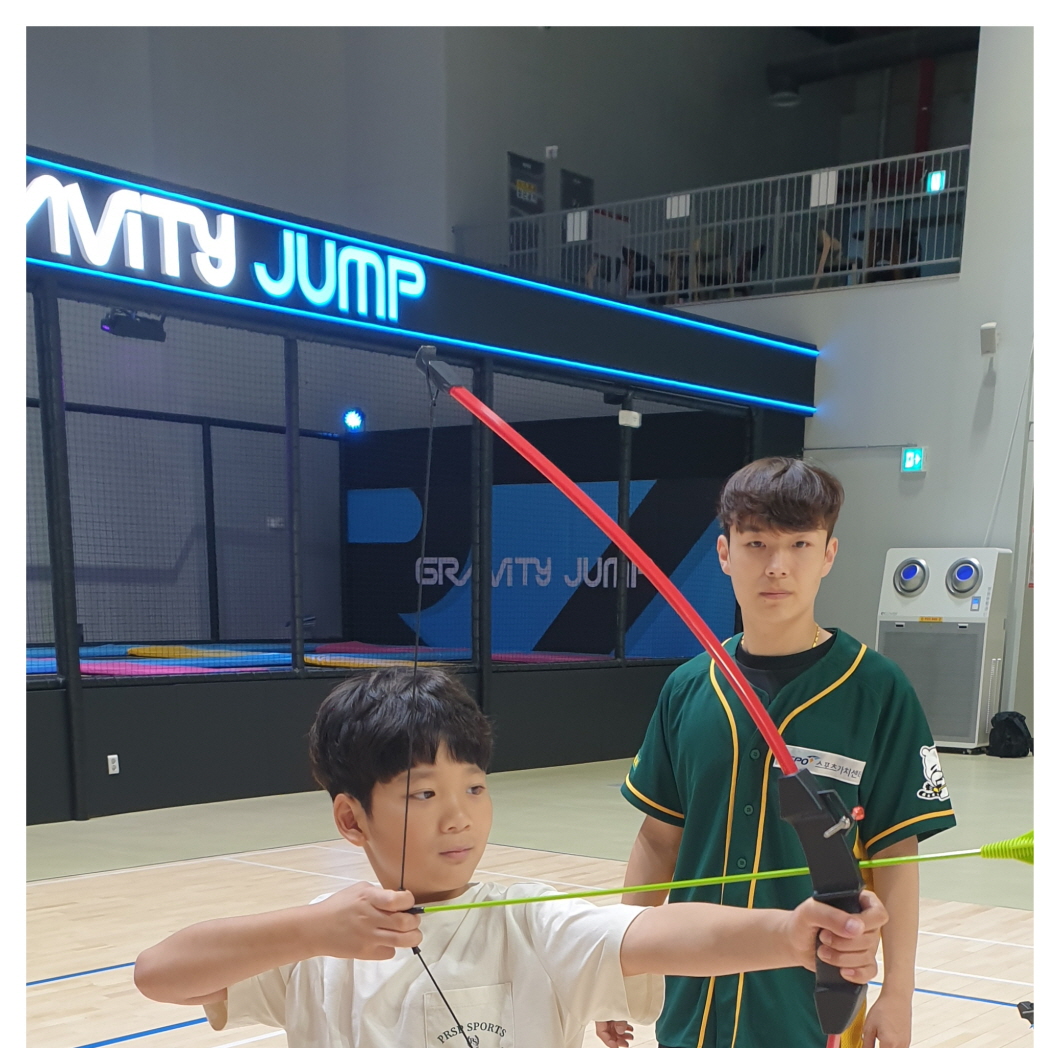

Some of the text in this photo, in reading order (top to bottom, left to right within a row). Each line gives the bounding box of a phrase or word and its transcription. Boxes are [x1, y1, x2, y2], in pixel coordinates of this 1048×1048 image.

[253, 228, 426, 322] JUMP
[415, 557, 551, 587] GRVITY
[467, 1022, 507, 1037] SPORTS
